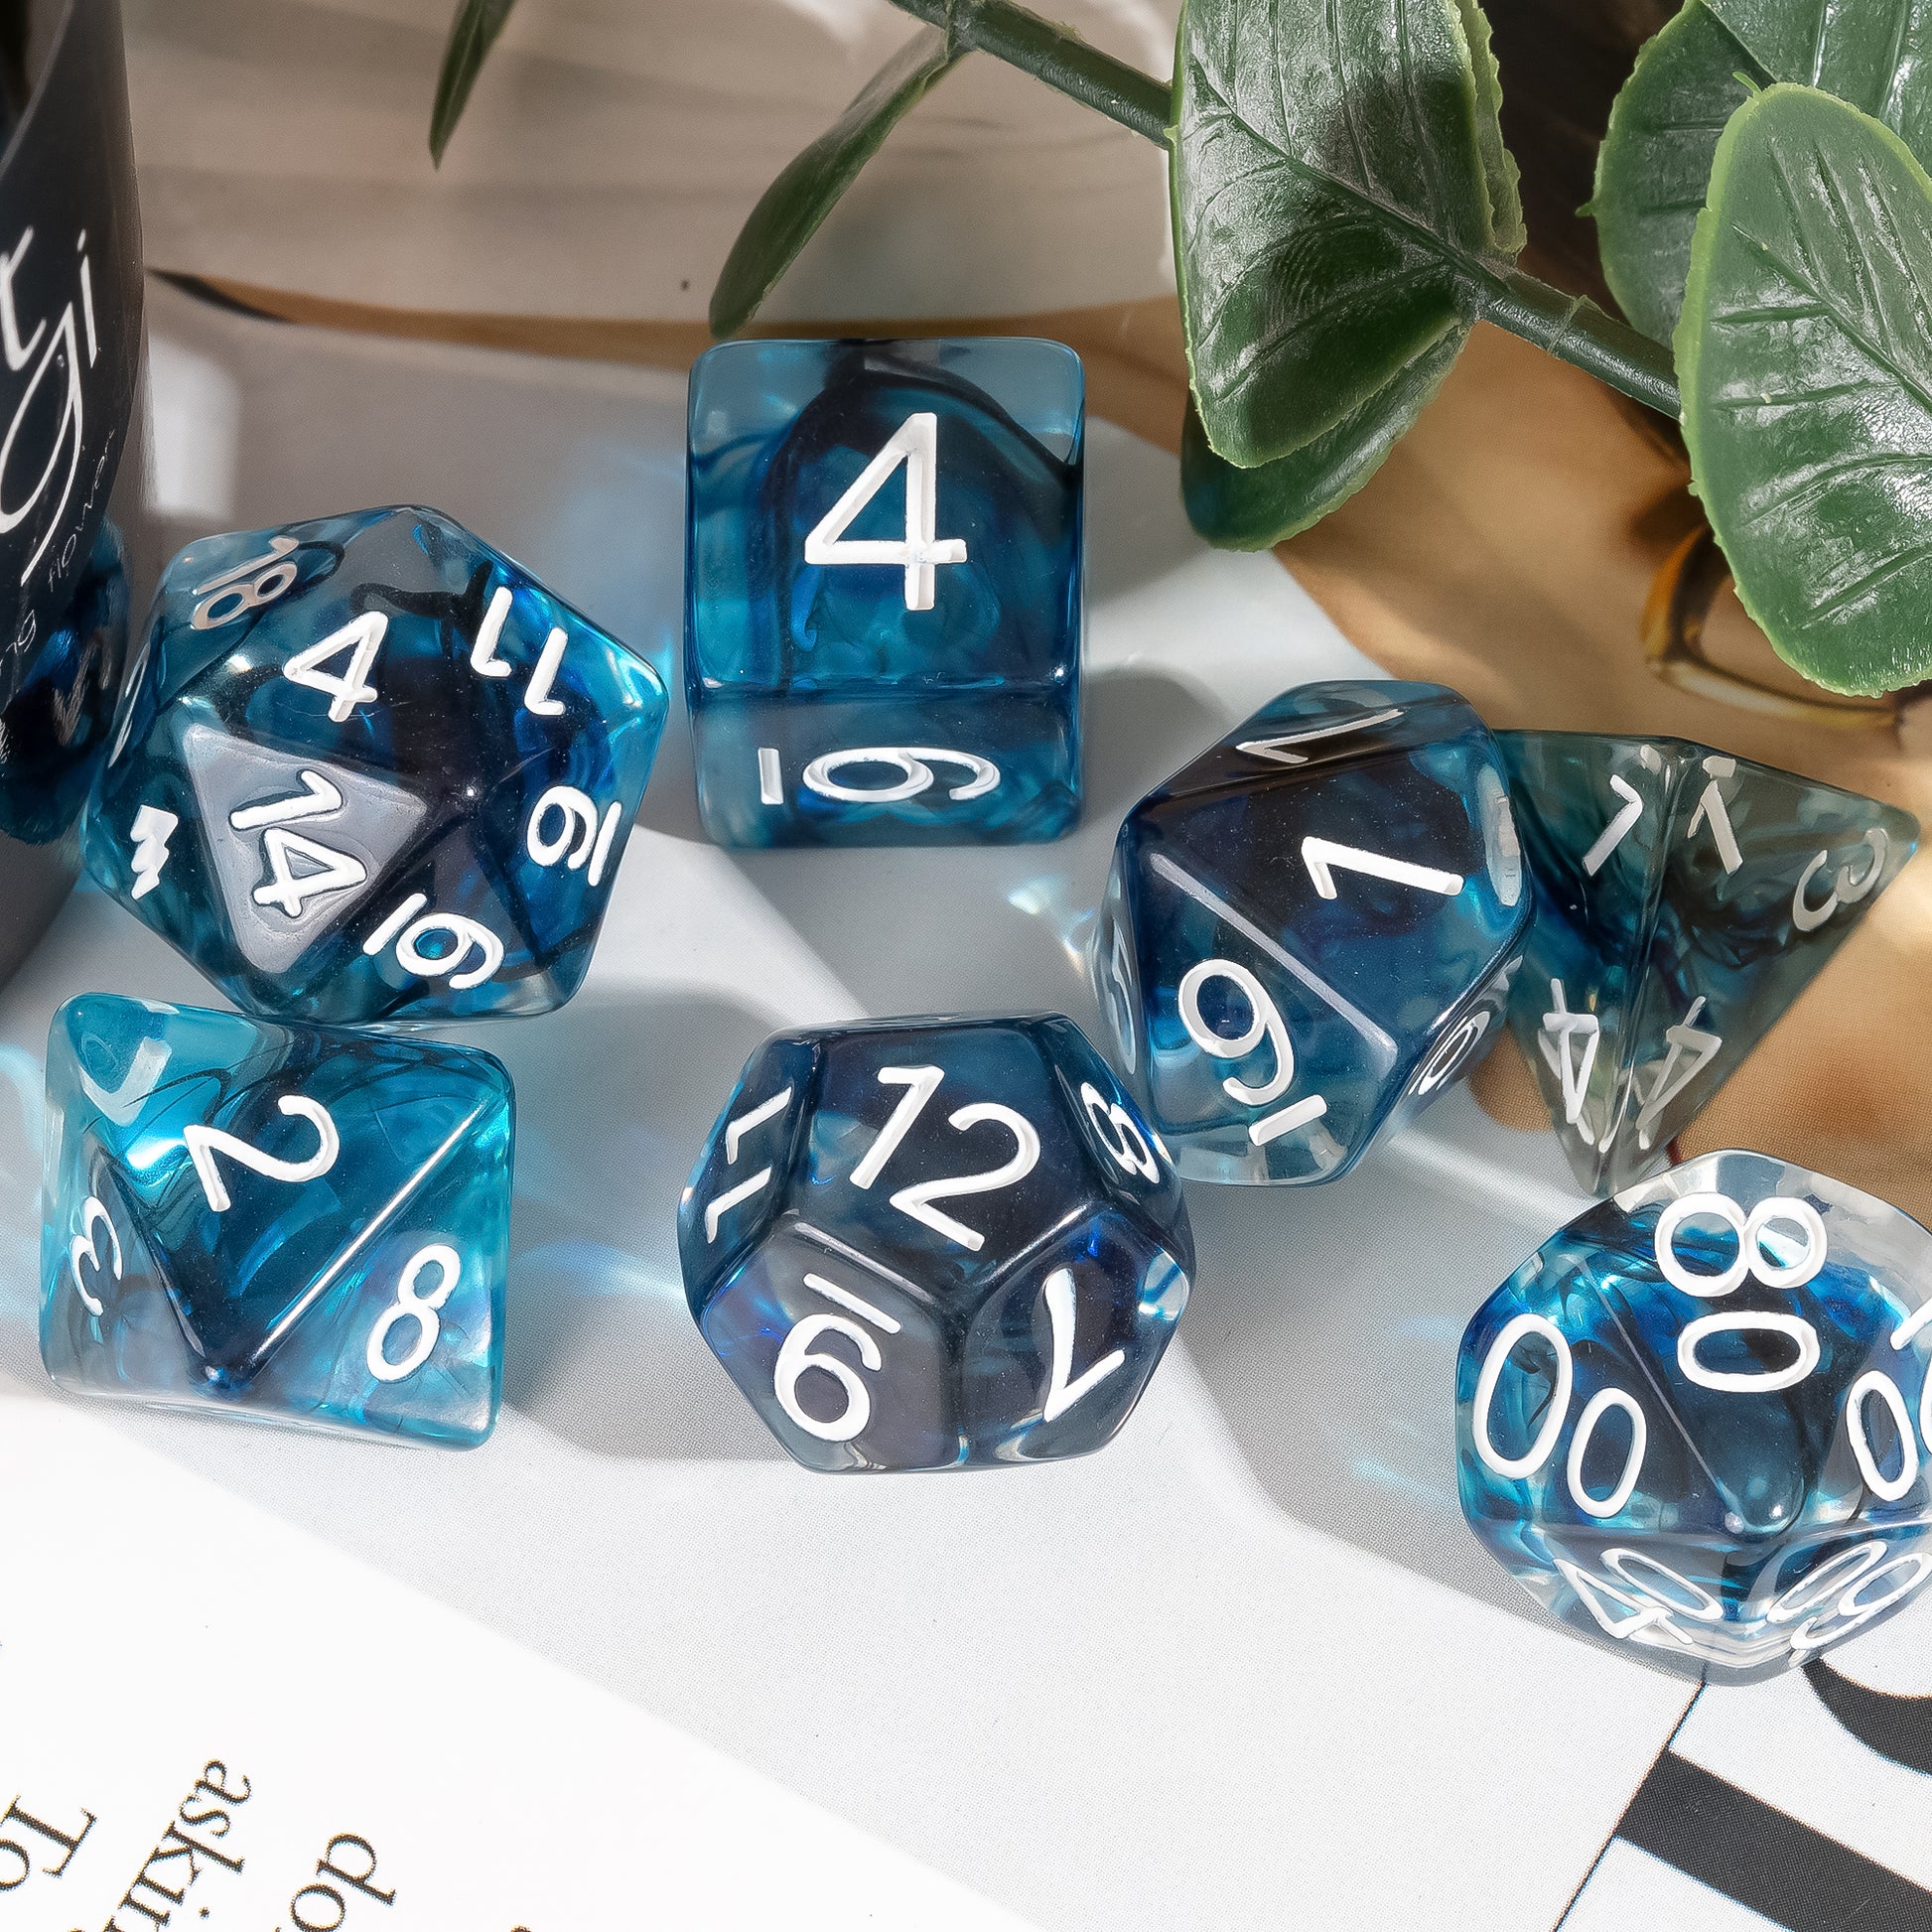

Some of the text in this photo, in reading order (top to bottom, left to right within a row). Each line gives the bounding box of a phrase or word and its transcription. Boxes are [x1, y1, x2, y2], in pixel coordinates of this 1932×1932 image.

[804, 411, 969, 612] 4
[282, 610, 389, 723] 4
[227, 769, 368, 919] 14
[183, 1093, 341, 1213] 2
[848, 1063, 1042, 1253] 12
[68, 1194, 124, 1317] 3
[364, 1242, 463, 1384] 8
[1654, 1191, 1829, 1393] 80
[1471, 1312, 1648, 1519] 00
[69, 1757, 253, 1932] askin
[273, 1832, 398, 1932] do
